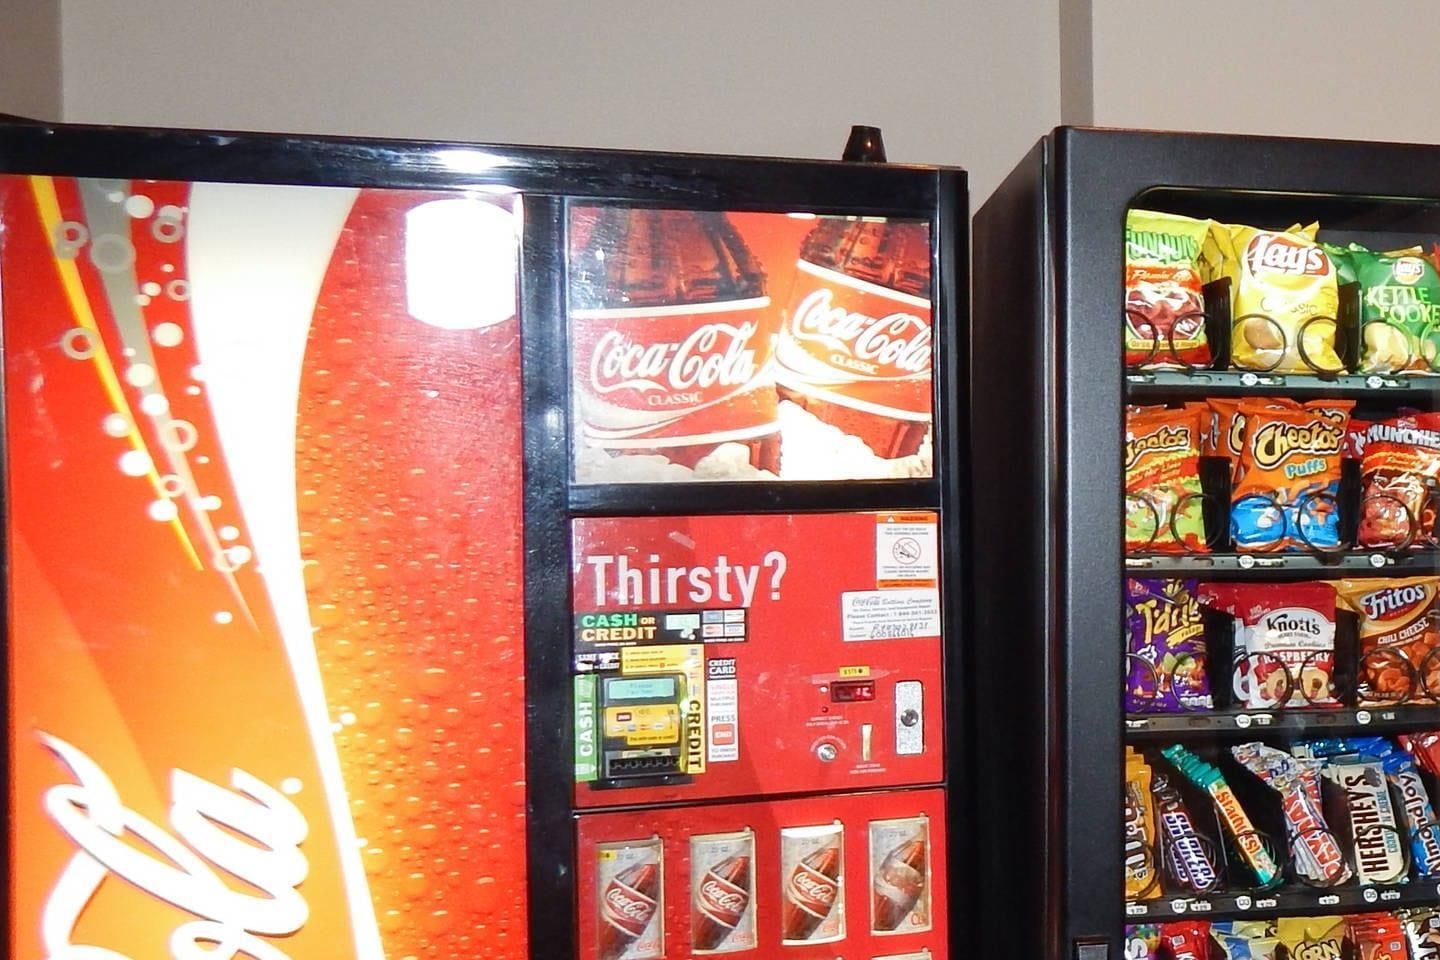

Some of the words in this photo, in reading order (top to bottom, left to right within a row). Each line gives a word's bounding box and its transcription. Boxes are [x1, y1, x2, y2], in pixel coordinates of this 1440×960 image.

[1366, 286, 1429, 305] KETTLE
[792, 288, 931, 373] Coca-Cola
[591, 322, 758, 392] Coca-Cola
[831, 353, 879, 374] CLASSIC
[647, 390, 703, 407] CLASSIC
[1252, 421, 1345, 470] Cheetos
[1285, 458, 1327, 479] Puffs
[587, 551, 787, 608] Thirsty?
[1360, 585, 1425, 620] Fritos
[581, 613, 638, 627] CASH
[640, 617, 655, 626] OR
[1267, 613, 1321, 635] Knott's
[1377, 631, 1398, 644] CHILI
[1398, 617, 1431, 640] CHEESE
[581, 627, 657, 642] CREDIT
[708, 666, 736, 674] CARD
[580, 701, 593, 757] CASH
[711, 715, 736, 723] PRESS
[689, 700, 702, 769] CREDIT
[1399, 774, 1425, 807] Joy
[1345, 774, 1389, 874] HERSHEY'S
